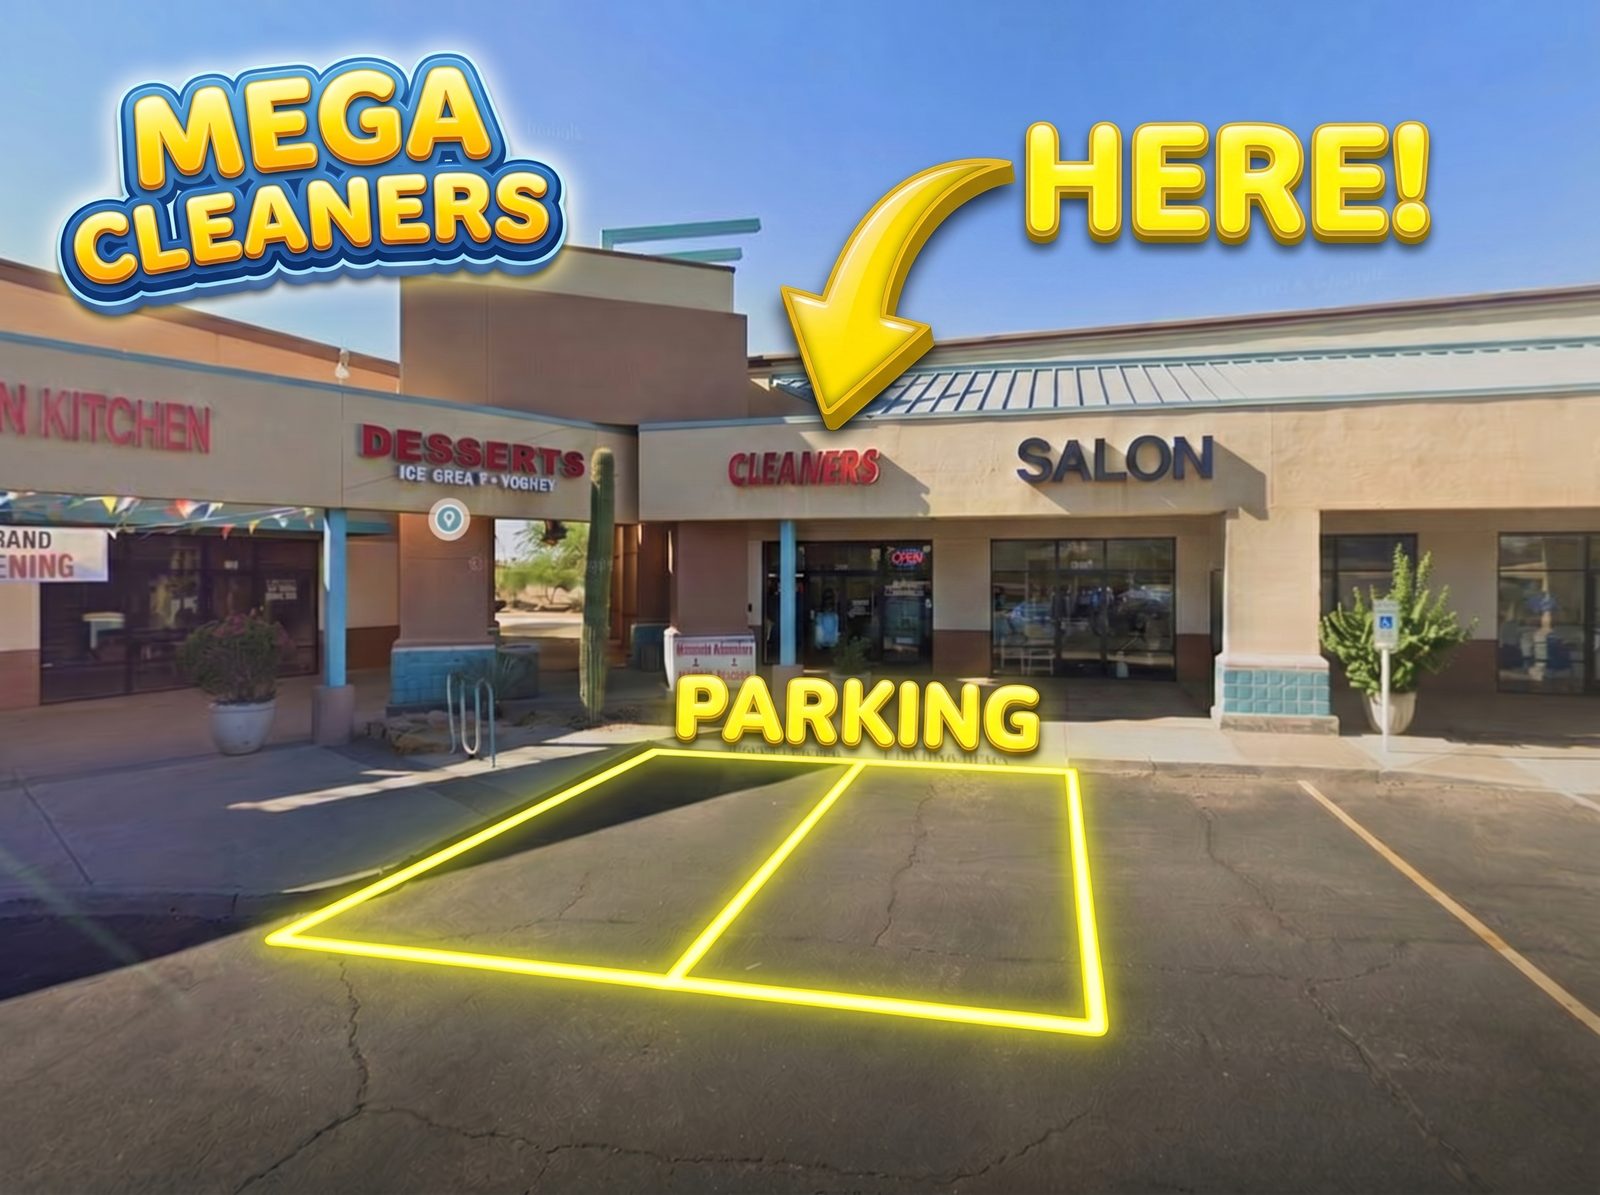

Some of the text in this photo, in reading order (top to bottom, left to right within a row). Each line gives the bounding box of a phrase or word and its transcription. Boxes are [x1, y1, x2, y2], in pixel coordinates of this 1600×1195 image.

[41, 386, 211, 455] KITCHEN
[361, 423, 586, 478] DESSERTS
[728, 448, 880, 487] CLEANERS
[1016, 434, 1214, 482] SALON
[399, 464, 426, 481] ICE
[892, 551, 923, 565] OPEN
